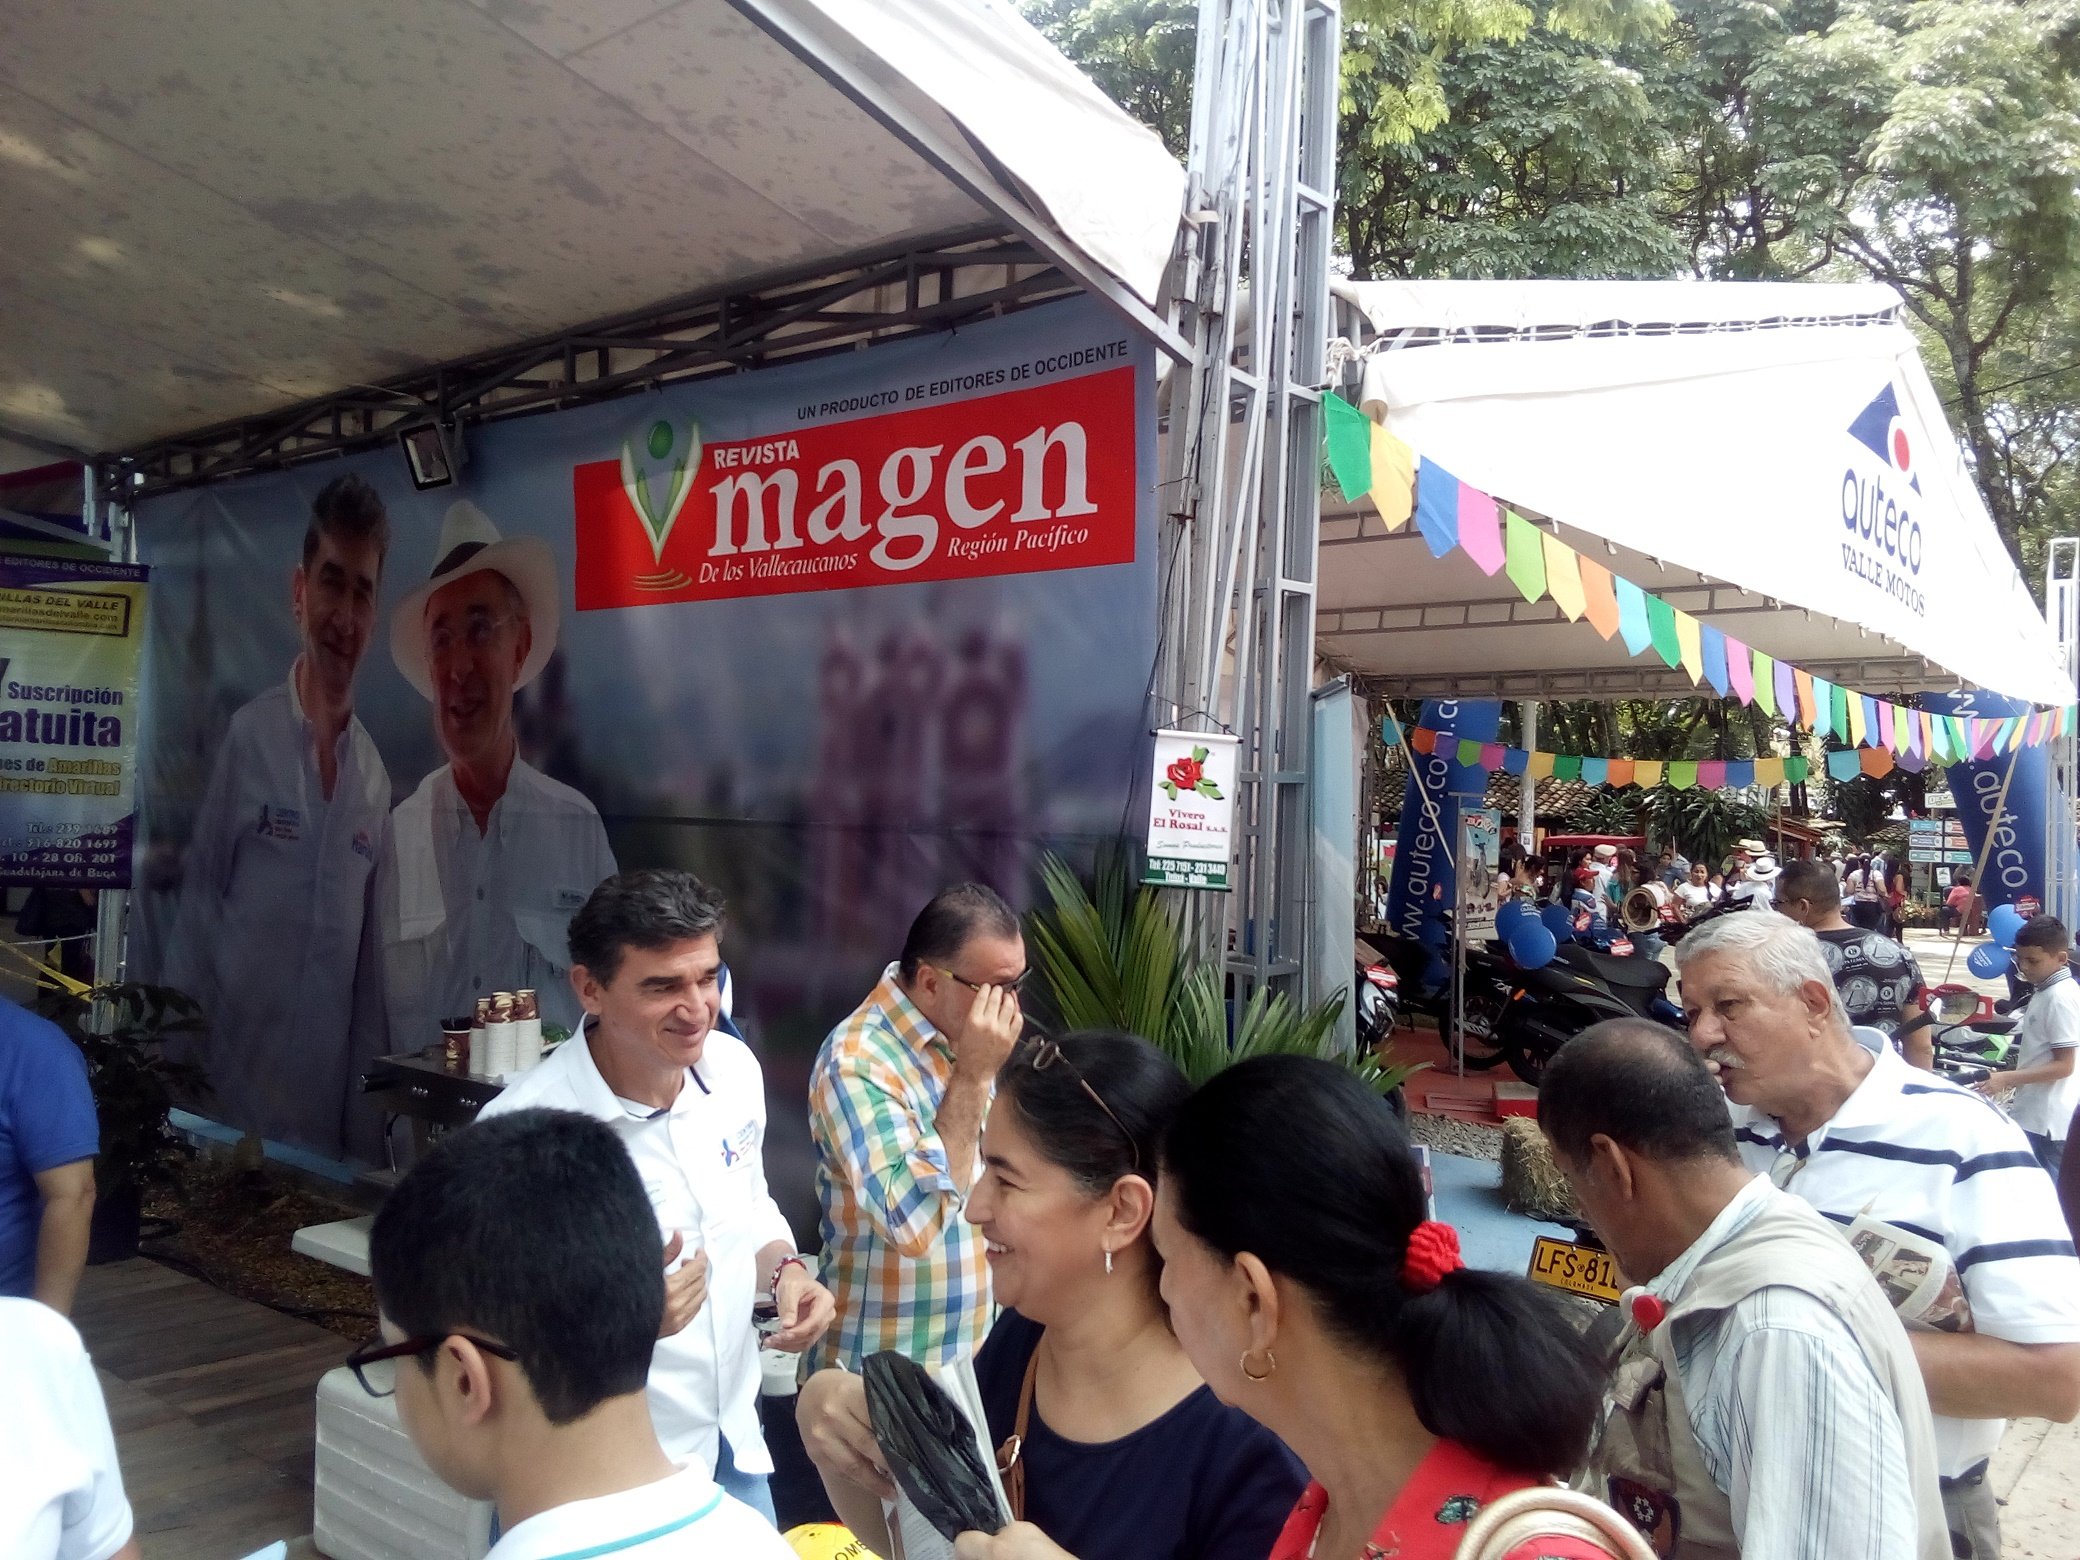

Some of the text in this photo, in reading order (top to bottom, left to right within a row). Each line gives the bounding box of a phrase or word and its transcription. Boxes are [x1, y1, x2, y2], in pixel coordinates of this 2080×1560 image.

[797, 339, 1129, 421] UN PRODUCTO DE EDITORES DE OCCIDENTE
[714, 438, 800, 469] REVISTA
[706, 418, 1098, 571] magen
[1841, 468, 1922, 576] auteco
[947, 524, 1089, 561] Región Pacífico
[4, 557, 141, 577] EDITORES DE OCCIDENTE
[699, 552, 858, 584] De los Vallecaucanos
[1841, 543, 1925, 618] VALLE MOTOS
[44, 596, 72, 608] DEL
[77, 598, 120, 611] VALLE
[7, 680, 123, 706] Suscripción
[25, 757, 45, 772] de
[47, 757, 122, 775] Amarillas
[67, 778, 121, 796] Virtual
[1153, 818, 1165, 828] El
[1170, 819, 1203, 831] Rosal
[1169, 809, 1205, 820] Vivero
[54, 838, 82, 849] 820
[1536, 1247, 1619, 1290] LFS 81
